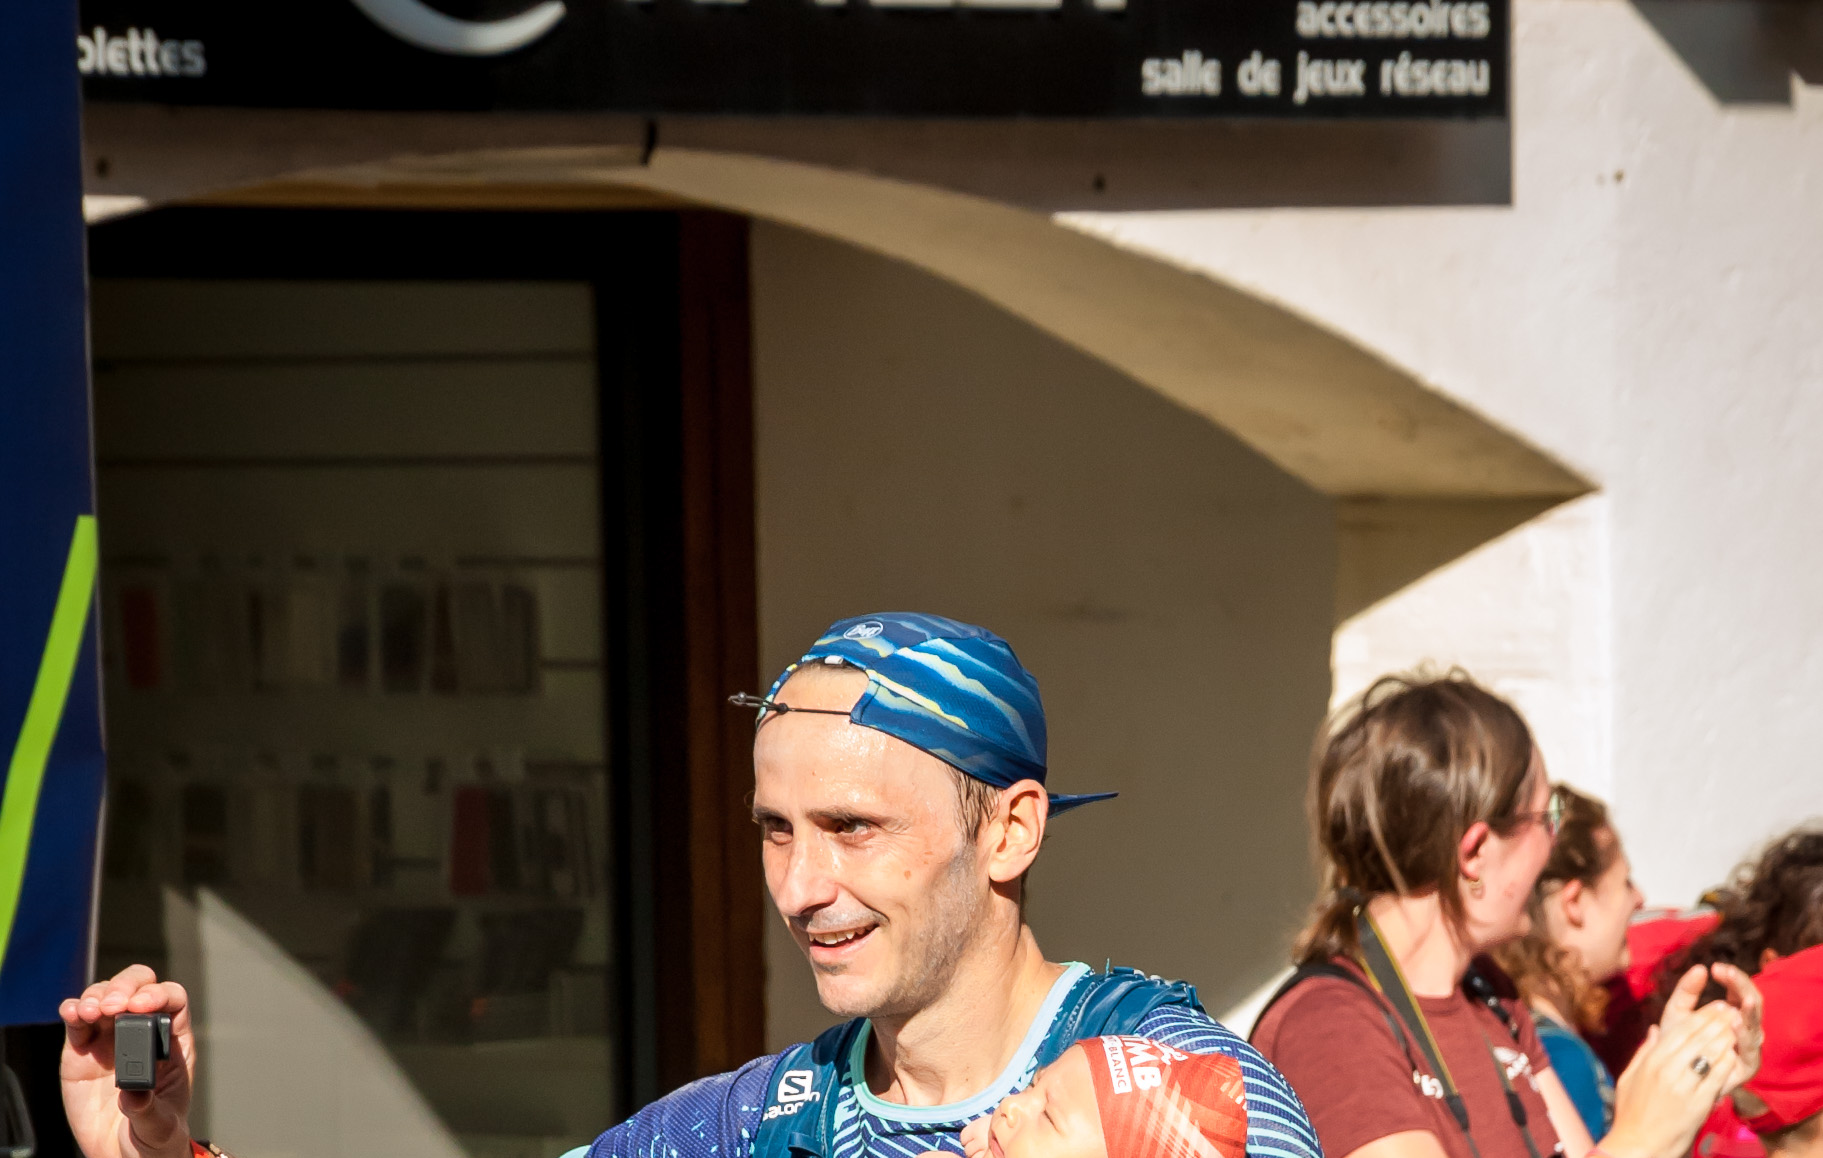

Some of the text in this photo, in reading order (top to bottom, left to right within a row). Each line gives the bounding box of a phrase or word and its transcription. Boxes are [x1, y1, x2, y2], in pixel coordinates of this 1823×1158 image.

[1295, 1, 1490, 38] accessoires
[1142, 50, 1490, 104] salle de jeux réseau
